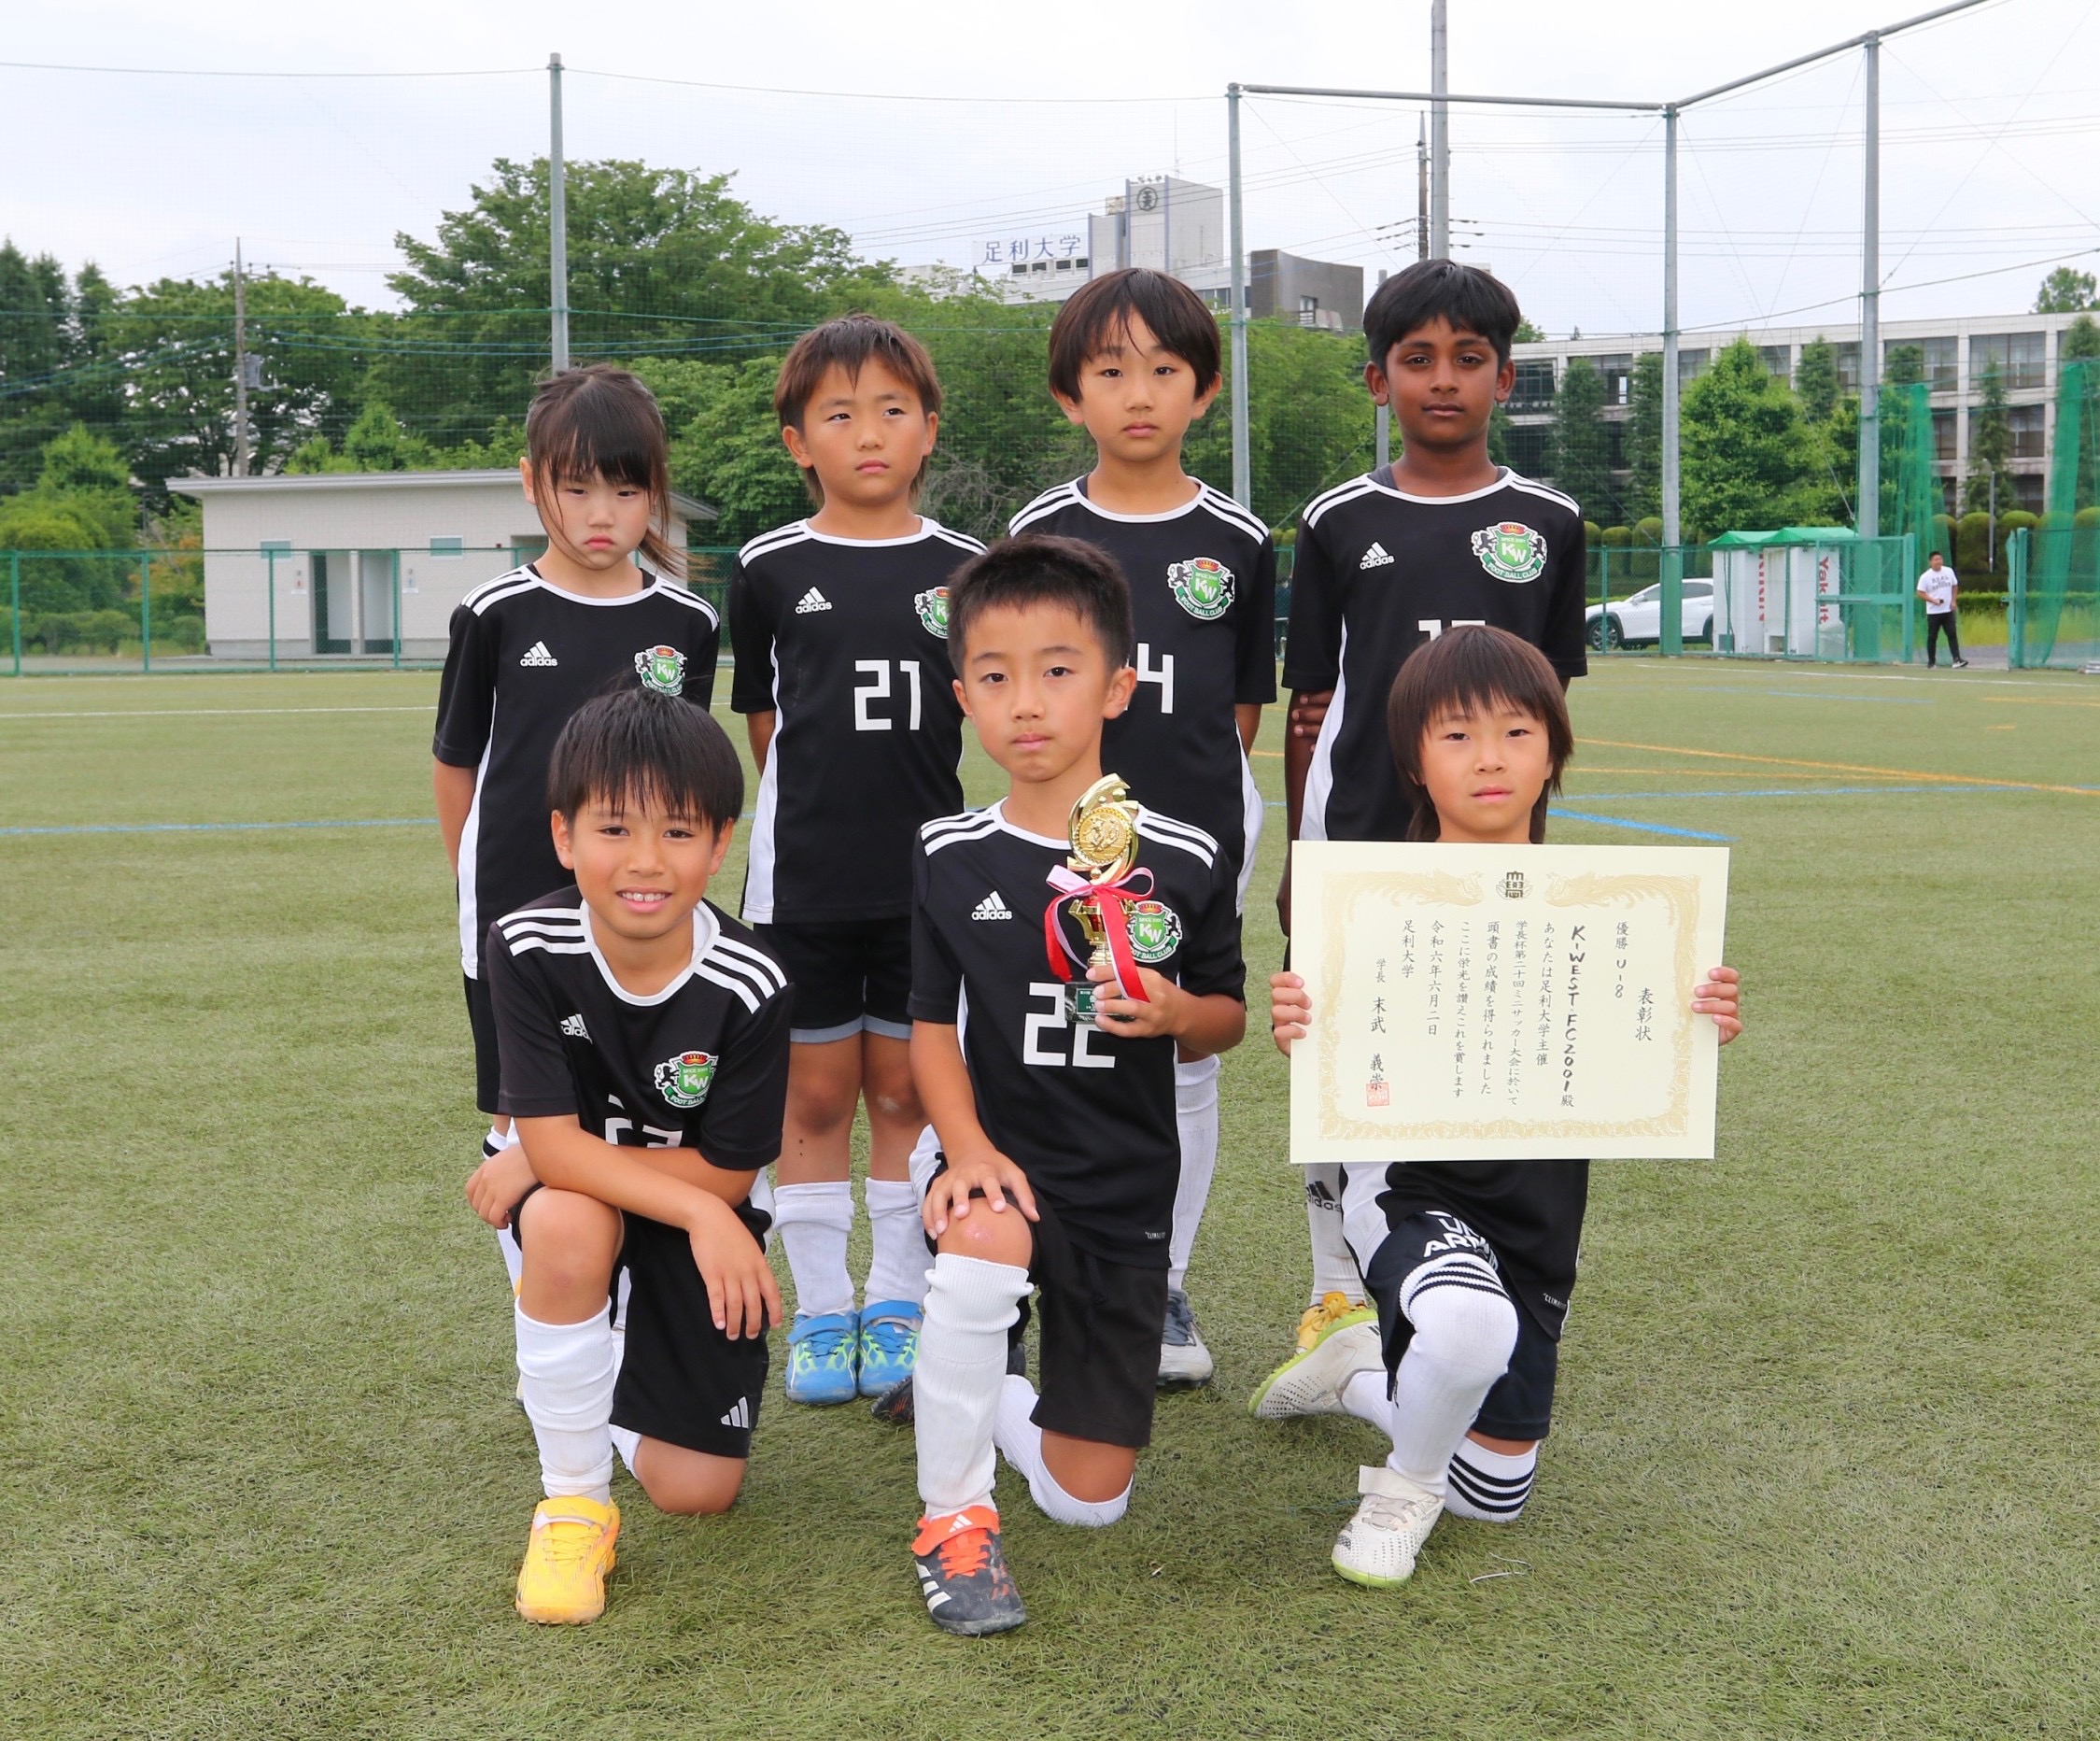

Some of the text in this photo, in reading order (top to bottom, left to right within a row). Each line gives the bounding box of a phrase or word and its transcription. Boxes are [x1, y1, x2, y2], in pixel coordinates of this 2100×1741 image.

[982, 235, 1081, 265] 足利大学
[1360, 555, 1395, 570] adidas
[795, 601, 833, 615] adidas
[519, 657, 558, 668] adidas
[853, 659, 922, 731] 21
[971, 909, 1013, 921] adidas
[1374, 957, 1387, 984] 学長
[1401, 919, 1416, 979] 足利大学
[1615, 921, 1628, 998] 優勝 U-8
[1426, 919, 1445, 1036] 令和六年六月二日
[1536, 921, 1556, 1067] あなたは足利大学主催
[1370, 996, 1387, 1034] 末武
[1480, 921, 1501, 1095] 頭書の成績を得られました
[1635, 987, 1654, 1041] 表彰状
